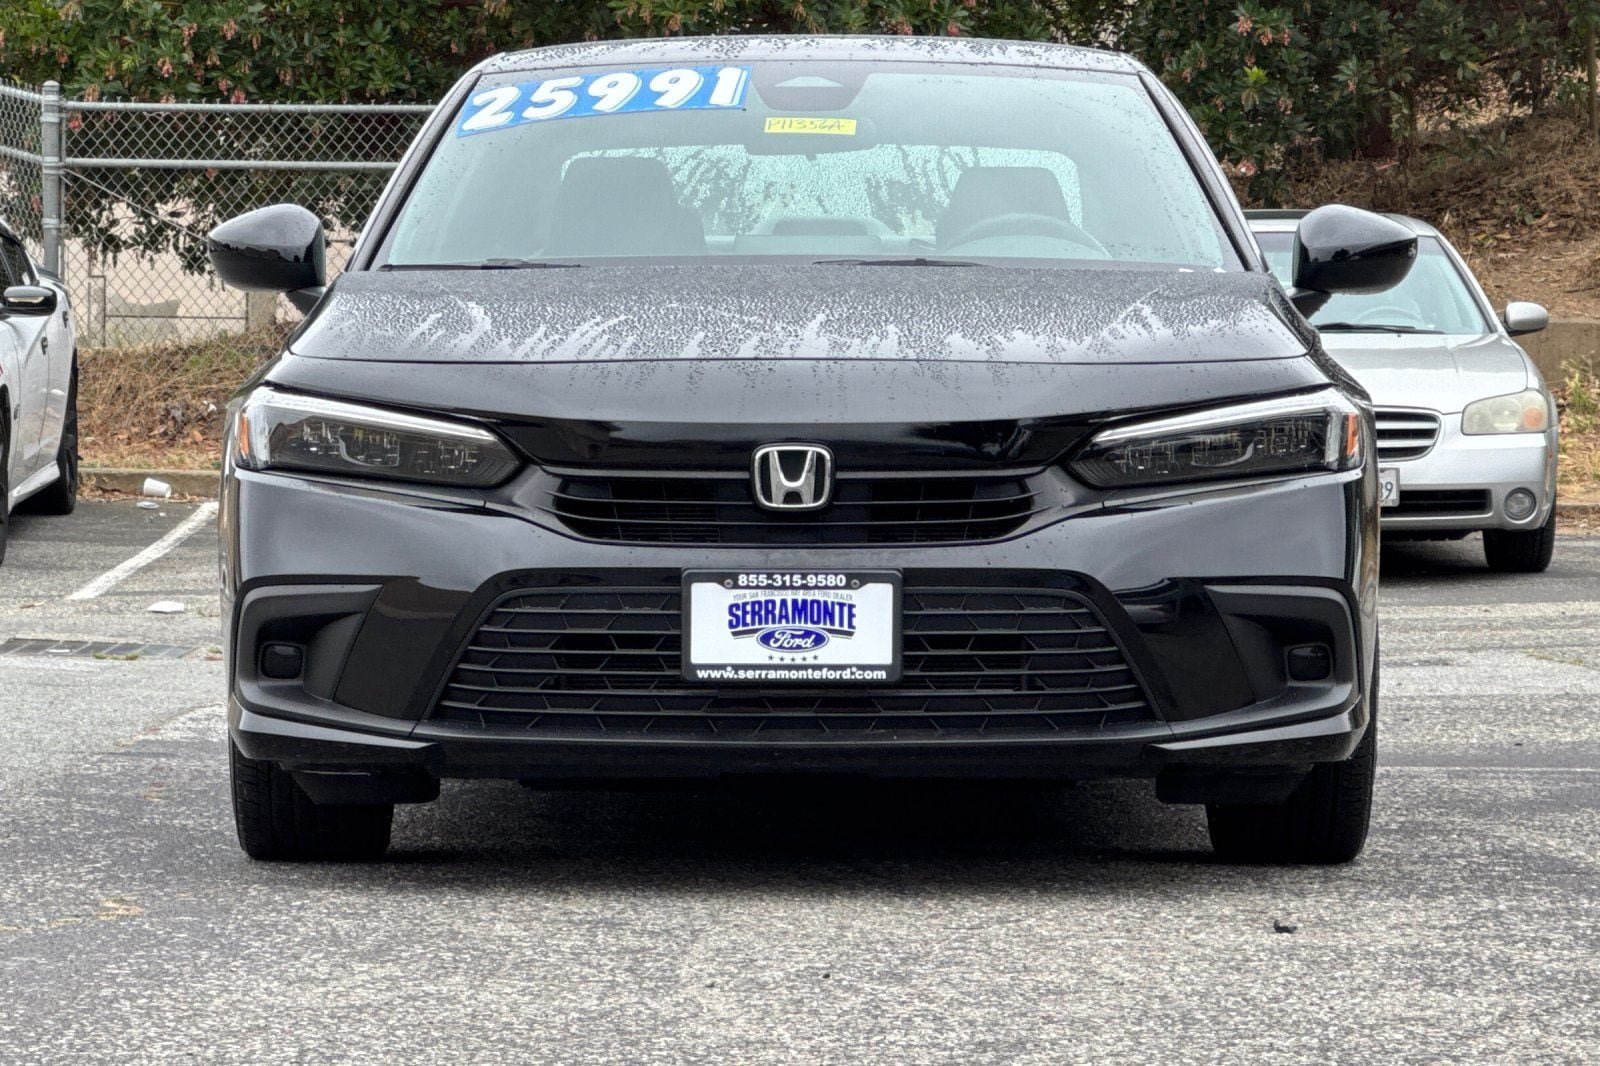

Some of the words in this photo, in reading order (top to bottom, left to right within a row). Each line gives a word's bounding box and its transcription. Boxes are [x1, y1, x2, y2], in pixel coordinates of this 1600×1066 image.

[462, 67, 748, 130] 25991
[738, 574, 847, 587] 855-315-9580
[733, 593, 747, 601] YOUR
[748, 591, 759, 599] SAN
[818, 590, 831, 599] FORD
[833, 592, 853, 601] DEALER
[728, 598, 856, 630] SERRAMONTE
[770, 630, 816, 648] Ford
[696, 668, 887, 679] www.serramonteford.com
